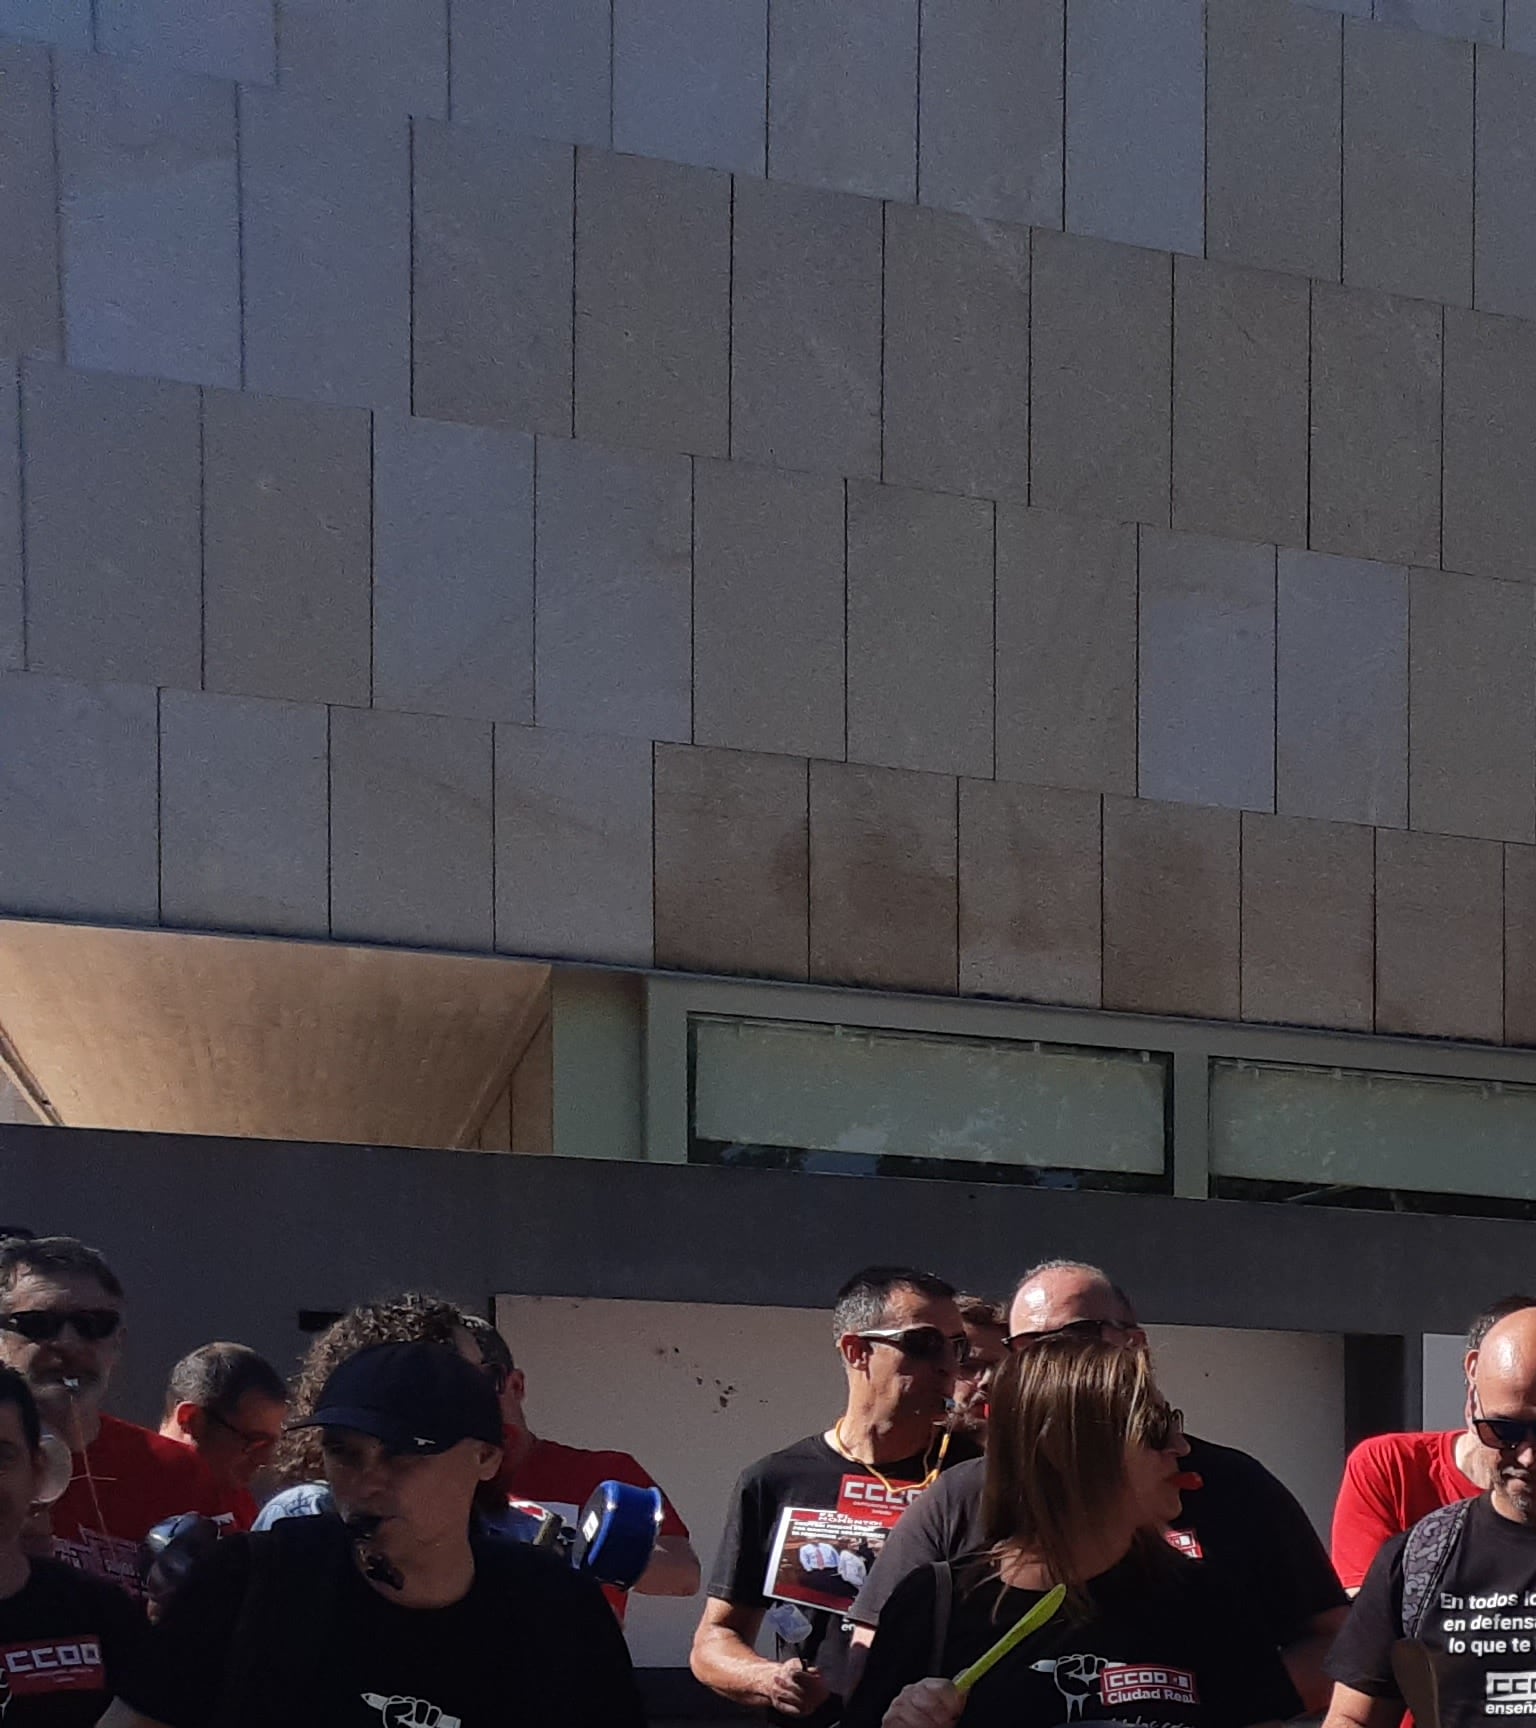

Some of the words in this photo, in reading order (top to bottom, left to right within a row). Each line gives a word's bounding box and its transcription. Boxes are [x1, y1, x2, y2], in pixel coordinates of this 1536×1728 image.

[1440, 1592, 1464, 1609] En
[1468, 1593, 1518, 1610] todos
[1443, 1618, 1466, 1632] en
[1448, 1637, 1466, 1654] lo
[1471, 1640, 1507, 1657] que
[1511, 1637, 1531, 1653] te
[5, 1642, 101, 1673] CCOO
[1110, 1672, 1168, 1688] CCOO
[1107, 1688, 1161, 1704] Ciudad
[1164, 1688, 1196, 1704] Real
